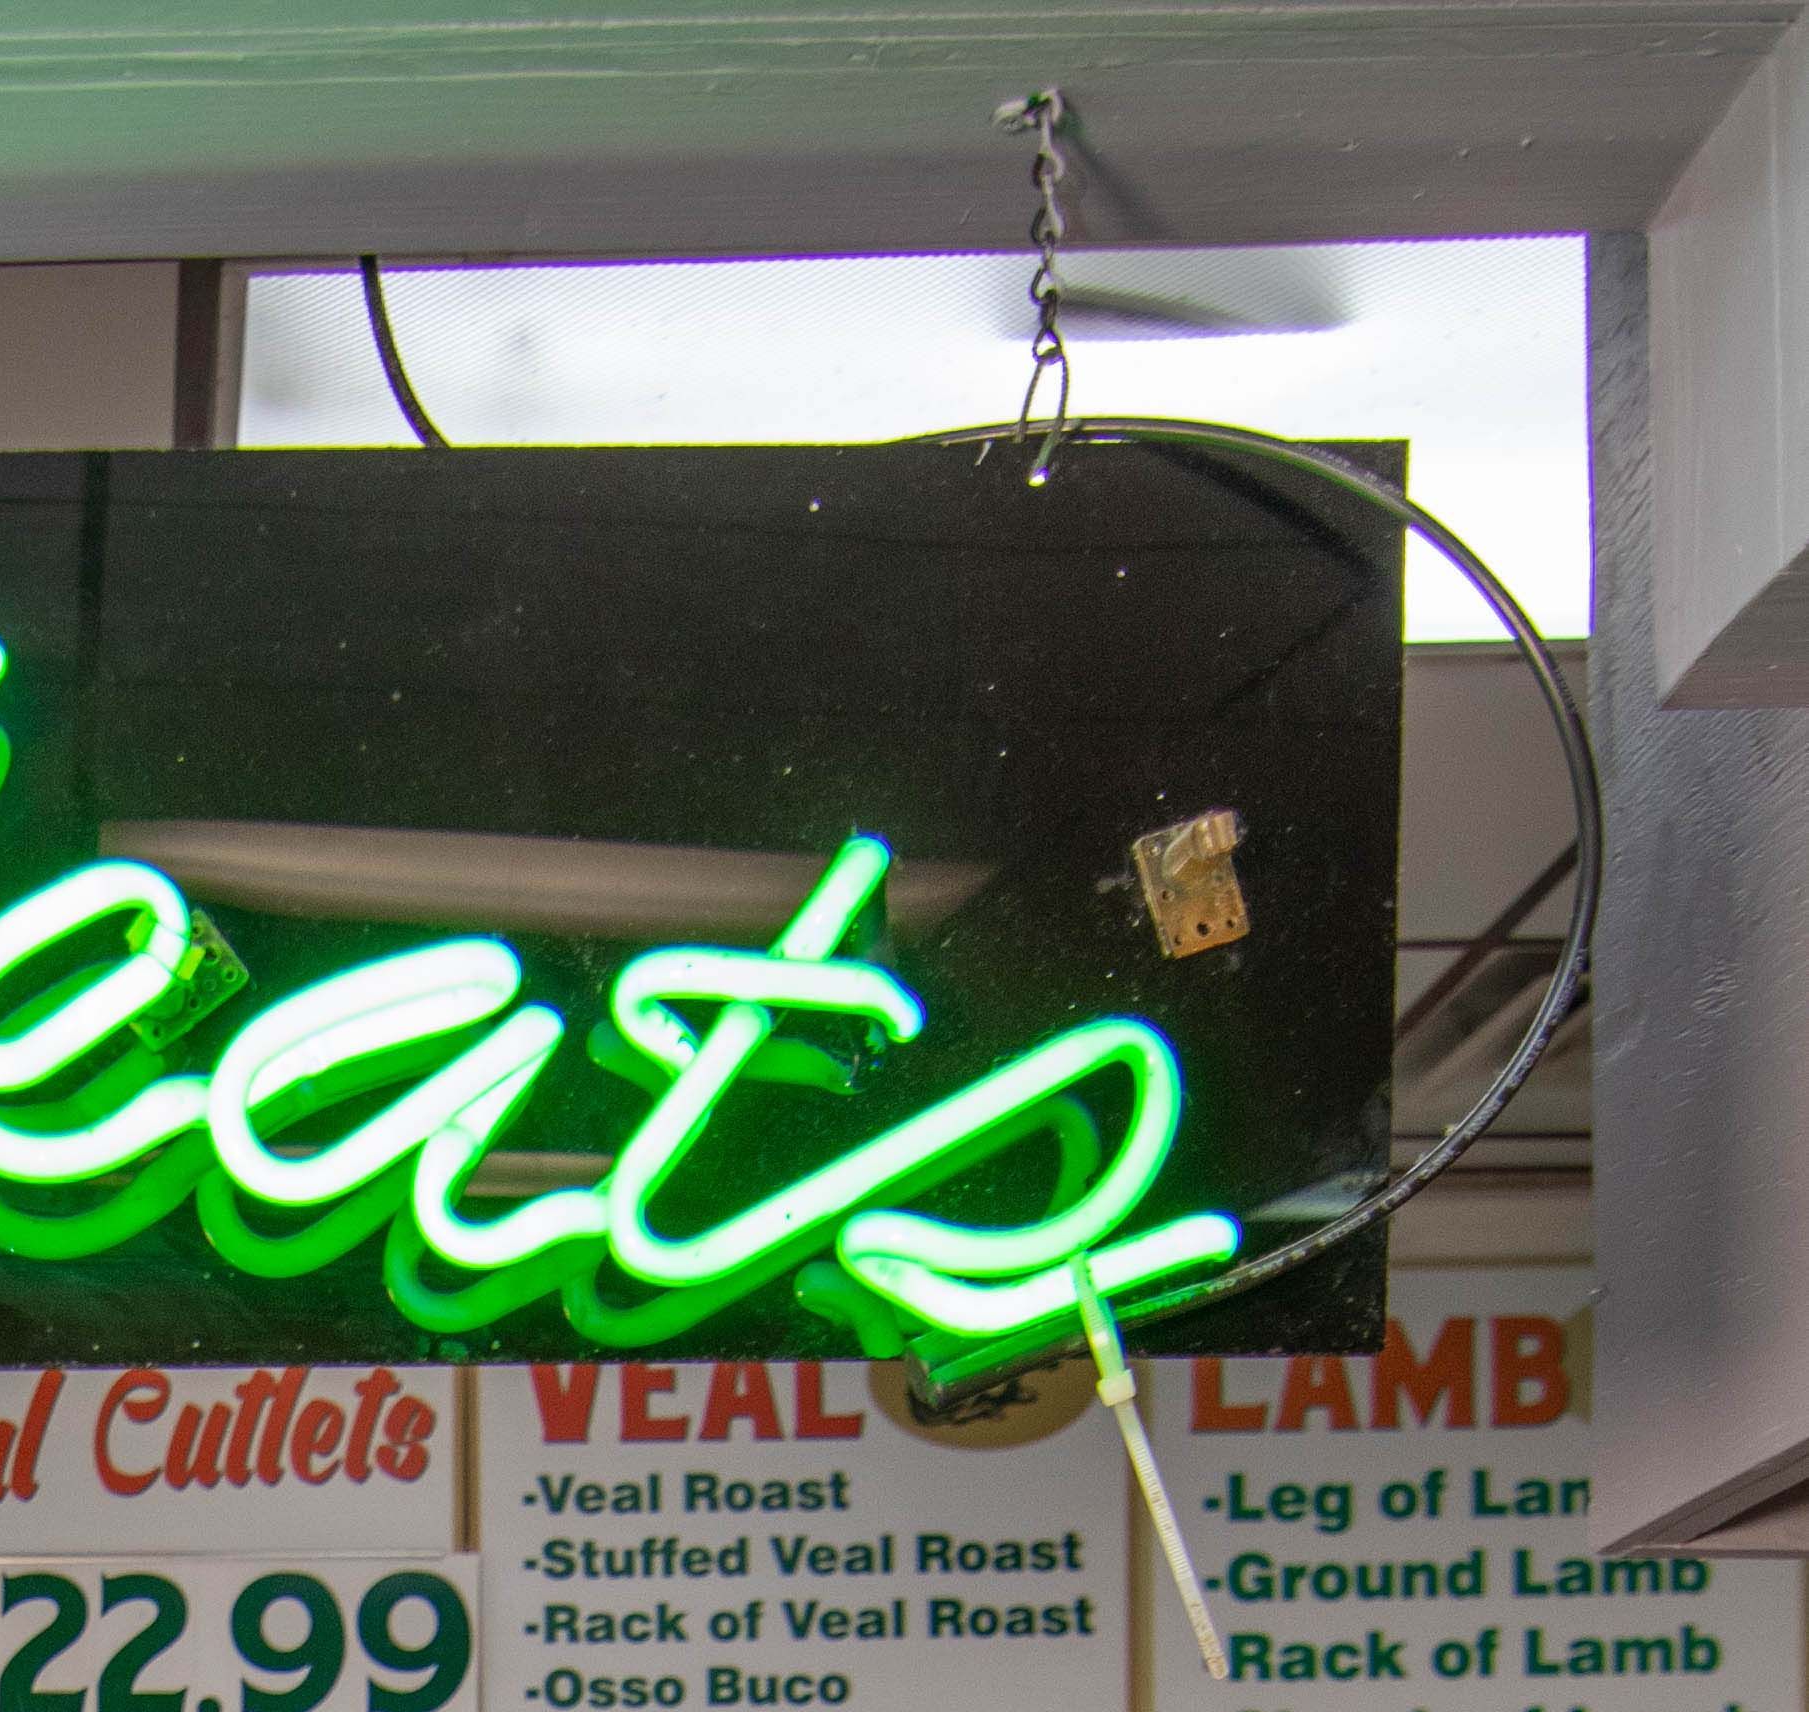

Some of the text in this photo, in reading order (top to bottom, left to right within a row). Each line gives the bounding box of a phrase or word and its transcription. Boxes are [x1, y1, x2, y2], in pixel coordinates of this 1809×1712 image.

[1190, 1316, 1569, 1432] LAMB
[529, 1361, 864, 1443] VEAL
[94, 1364, 437, 1496] Cutlets
[684, 1471, 851, 1512] Roast
[1380, 1470, 1446, 1518] of
[771, 1534, 897, 1576] Veal
[915, 1532, 1086, 1574] Roast
[1512, 1547, 1712, 1596] Lamb
[707, 1601, 764, 1640] of
[782, 1601, 908, 1640] Veal
[926, 1599, 1095, 1639] Roast
[1432, 1627, 1502, 1678] of
[1522, 1624, 1722, 1676] Lamb
[705, 1666, 851, 1706] Buco
